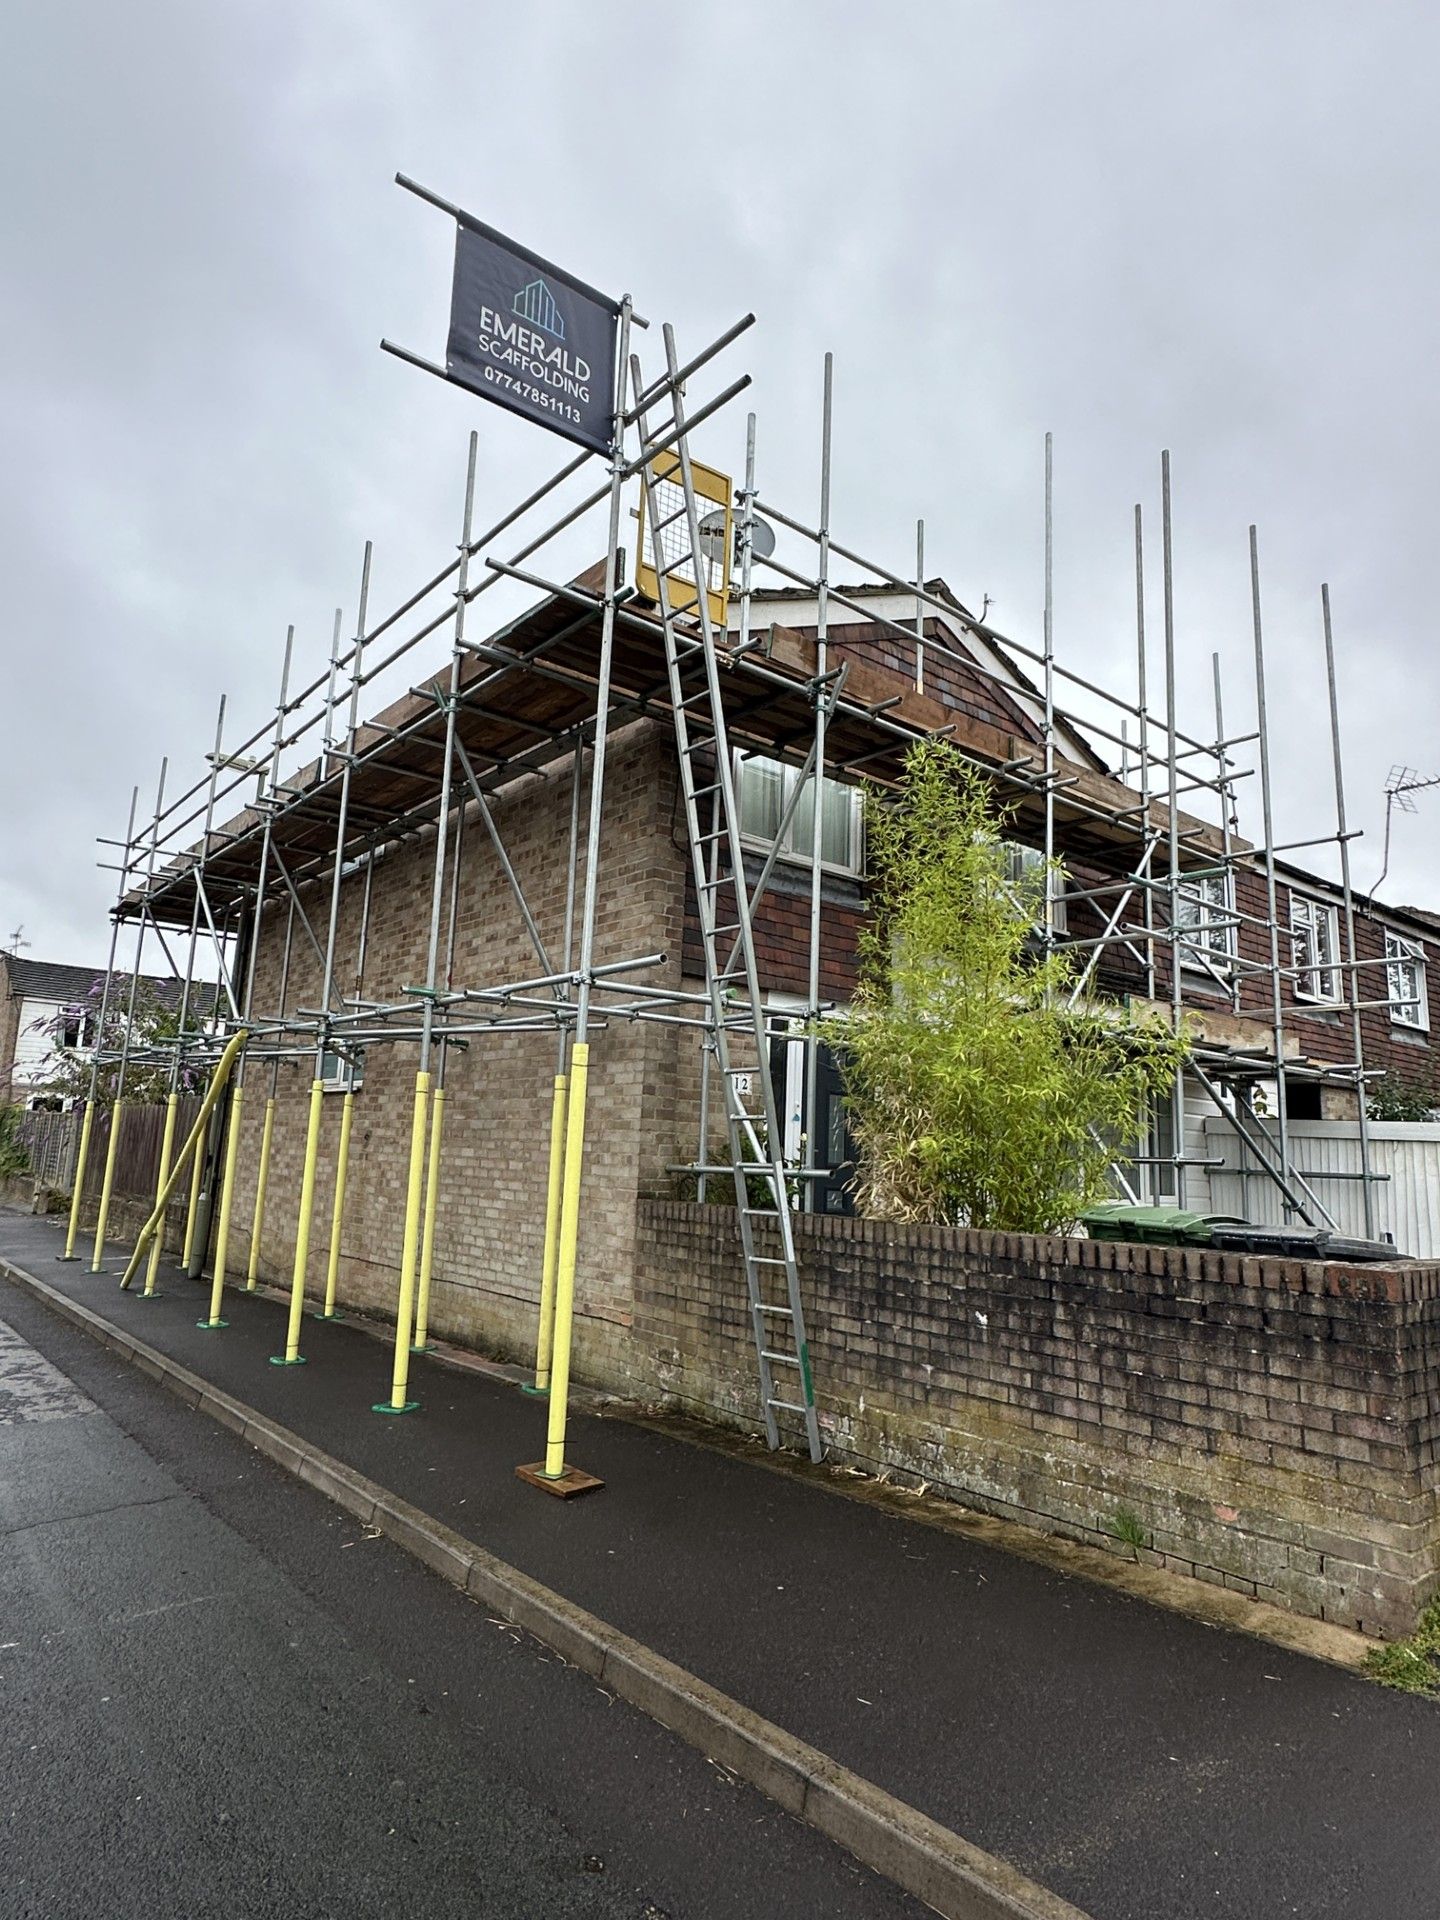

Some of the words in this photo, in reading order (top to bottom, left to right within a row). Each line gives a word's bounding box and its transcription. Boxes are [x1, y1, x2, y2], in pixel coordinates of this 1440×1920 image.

[478, 335, 590, 403] SCAFFOLDING
[480, 306, 590, 382] EMERALD
[484, 366, 581, 423] 07747851113
[735, 1077, 748, 1090] 12
